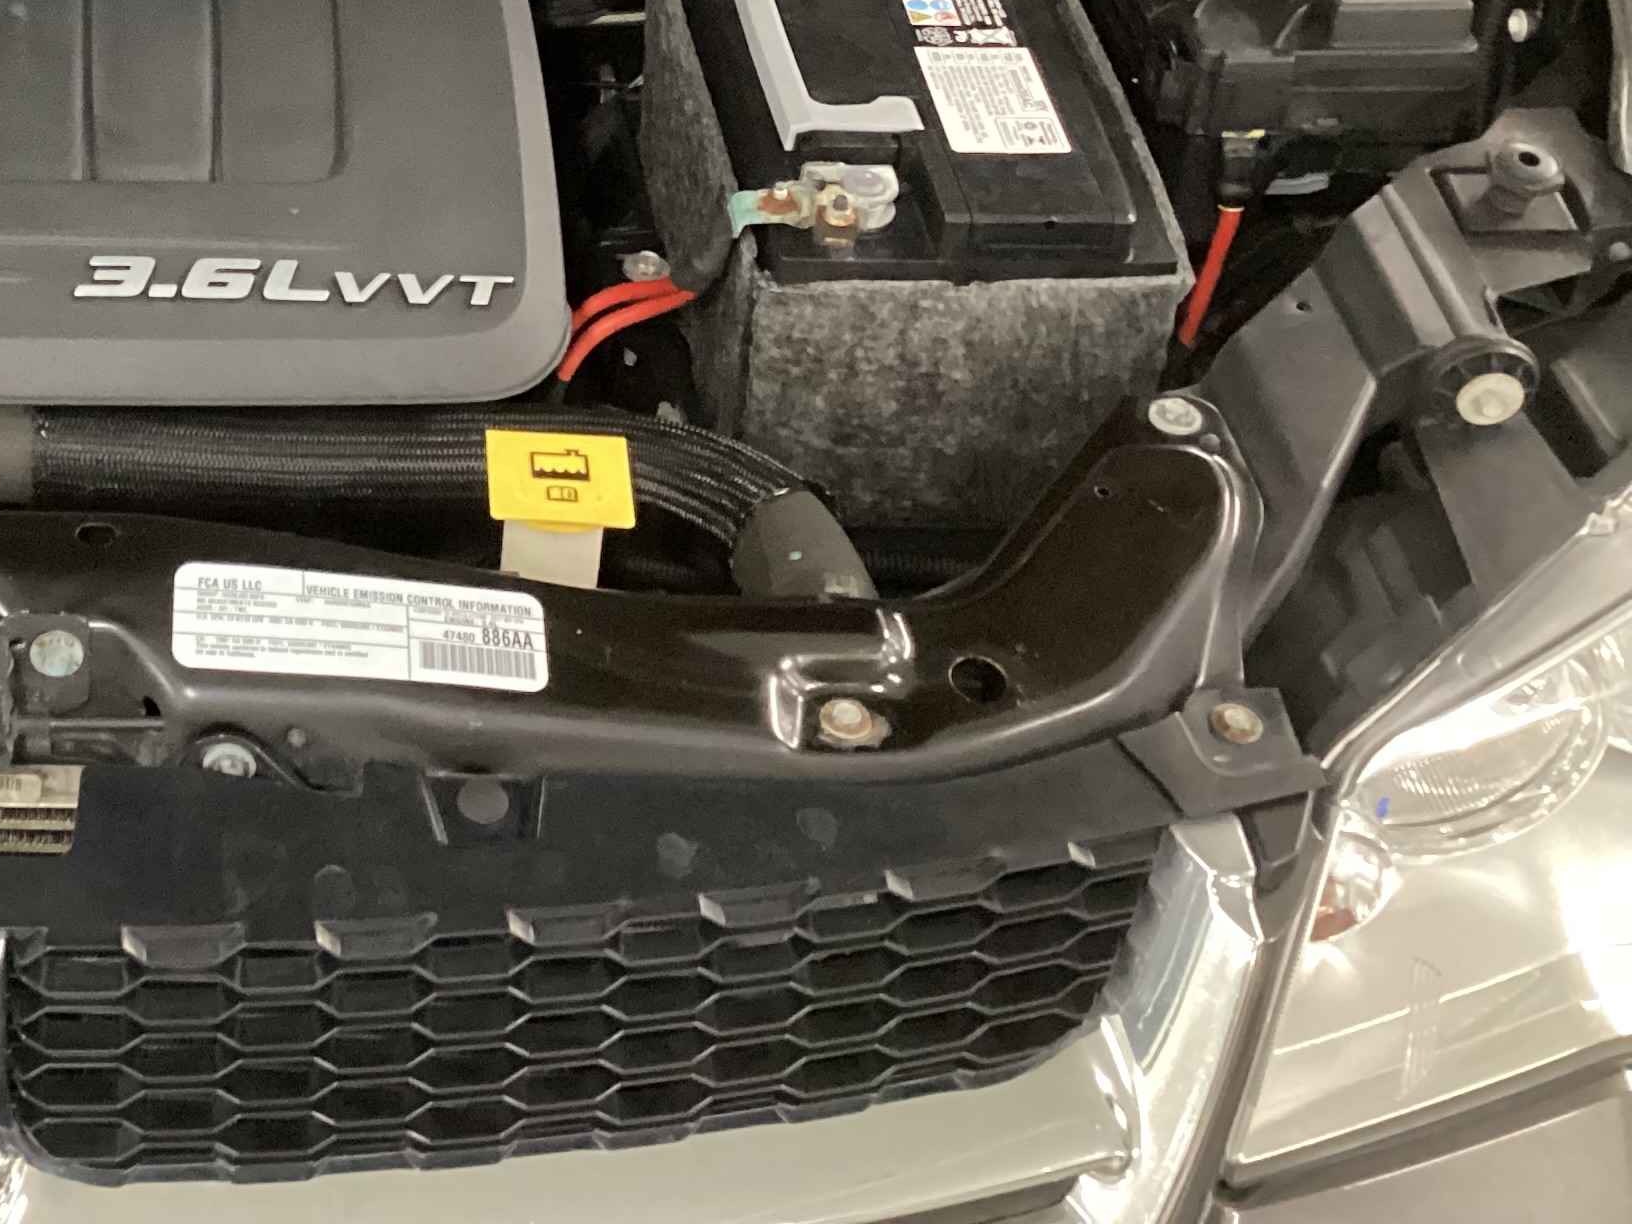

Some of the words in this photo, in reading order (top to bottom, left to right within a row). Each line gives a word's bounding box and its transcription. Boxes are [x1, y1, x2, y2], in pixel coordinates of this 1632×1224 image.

[73, 255, 330, 302] 3.6L
[334, 270, 515, 306] VVT
[197, 577, 219, 588] FCA
[223, 578, 238, 590] US
[242, 579, 263, 591] LLC
[306, 584, 349, 599] VEHICLE
[353, 588, 404, 603] EMISSION
[407, 594, 454, 608] CONTROL
[458, 600, 532, 617] INFORMATION
[442, 630, 475, 643] 47480
[482, 627, 534, 650] 886AA
